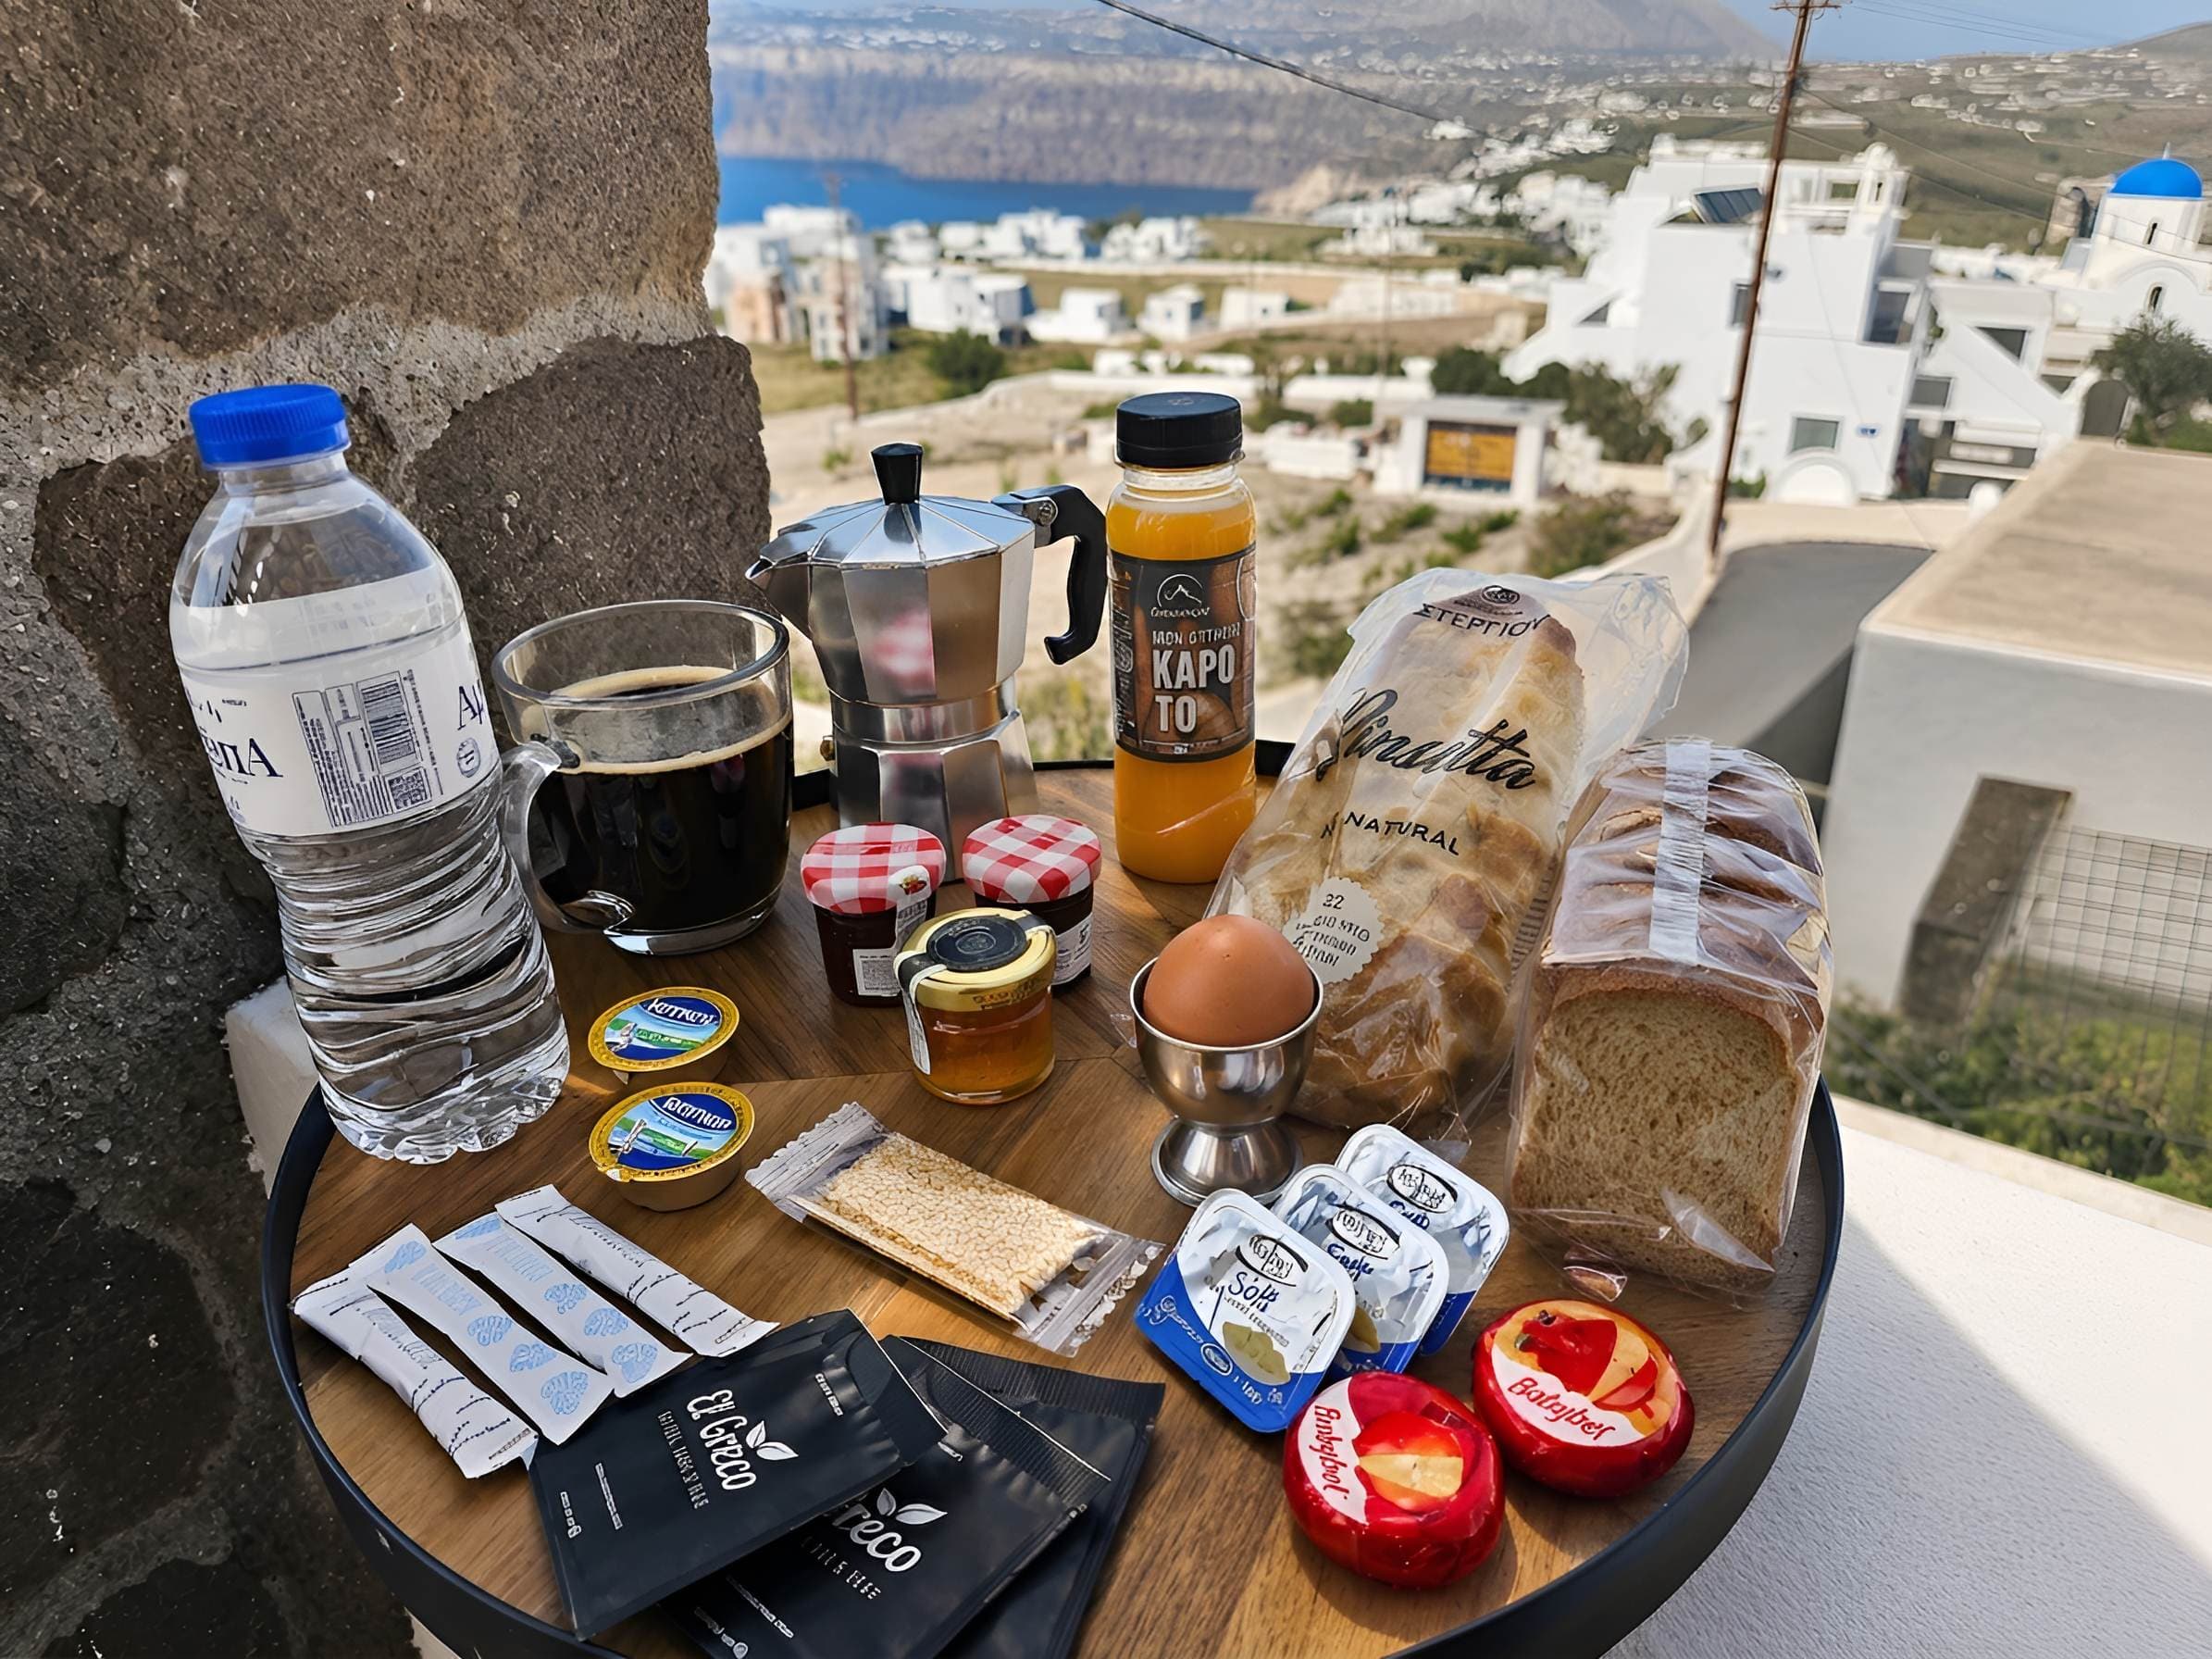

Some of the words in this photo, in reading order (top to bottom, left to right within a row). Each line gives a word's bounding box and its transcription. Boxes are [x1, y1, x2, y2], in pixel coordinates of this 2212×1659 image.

[1152, 643, 1236, 690] ΚΑΡΟ
[1154, 694, 1198, 733] ΤΟ
[1343, 809, 1460, 856] NATURAL
[700, 1416, 757, 1491] Greco
[832, 1494, 922, 1573] reco
